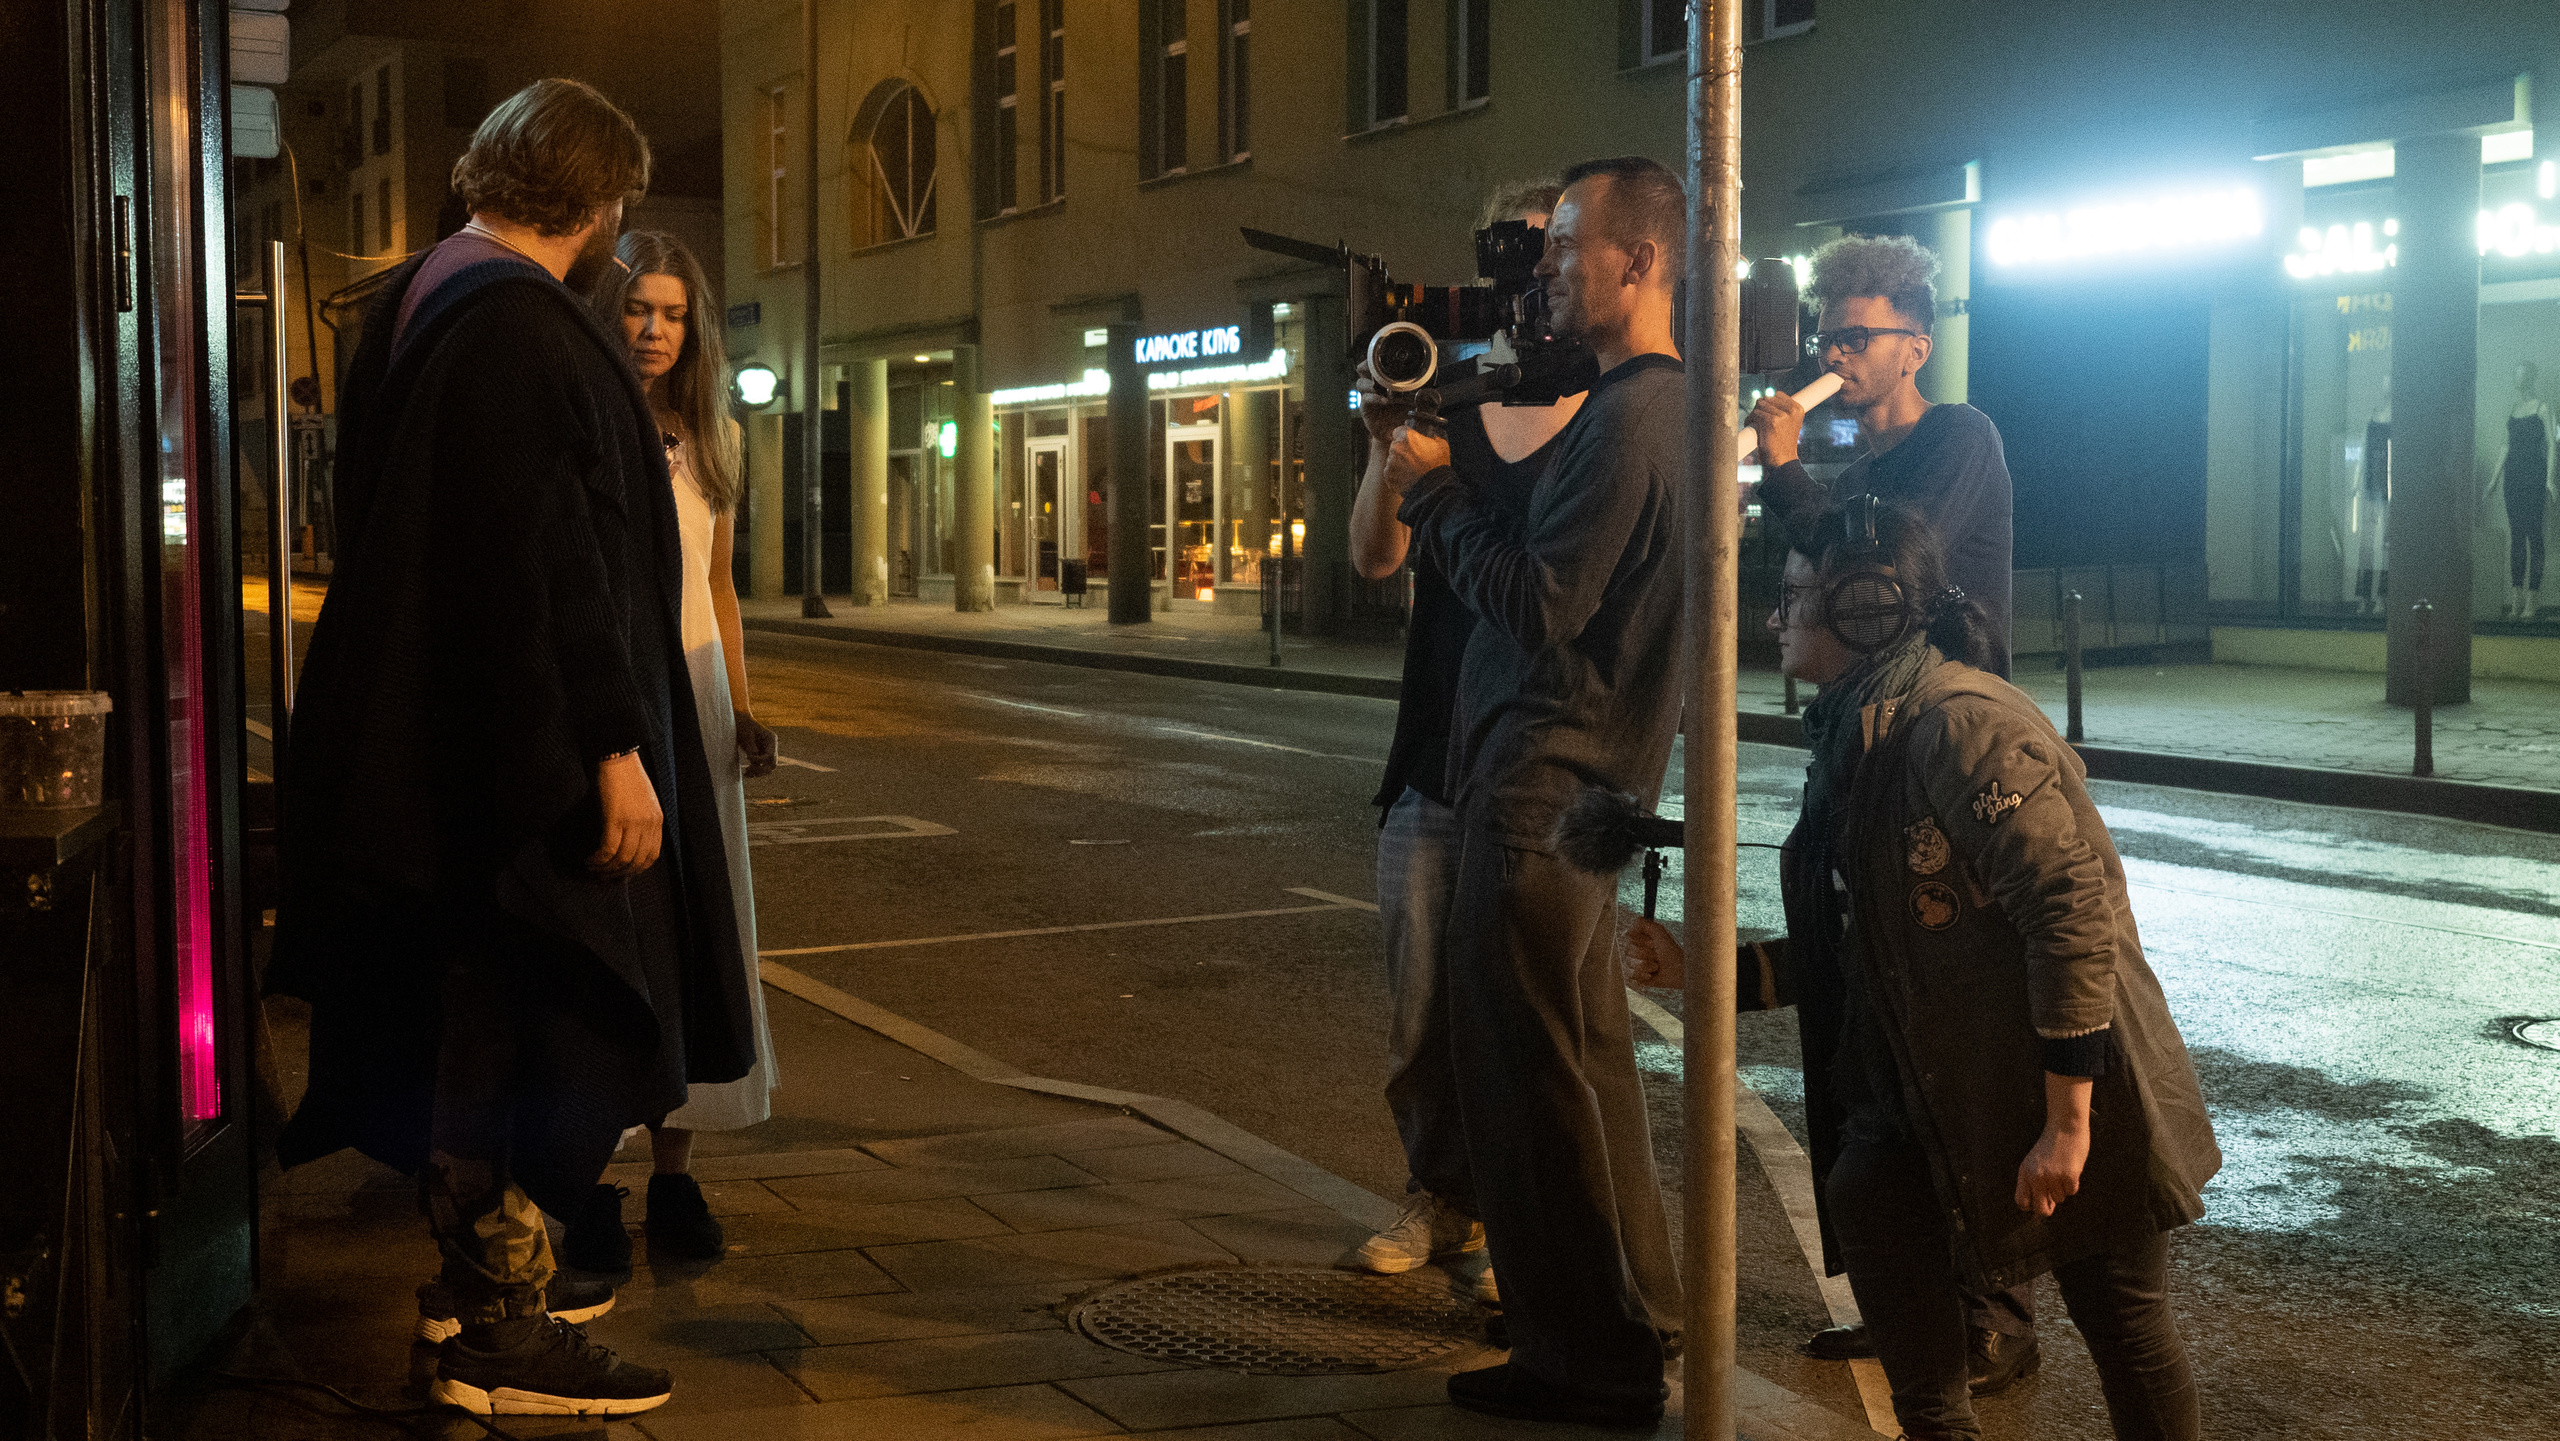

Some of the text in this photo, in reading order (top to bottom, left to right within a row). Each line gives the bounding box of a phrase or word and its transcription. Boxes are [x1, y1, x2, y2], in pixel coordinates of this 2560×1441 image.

[1135, 325, 1240, 364] КАРАОКЕ КЛУБ
[1973, 782, 2003, 820] girl
[1987, 793, 2023, 823] gang
